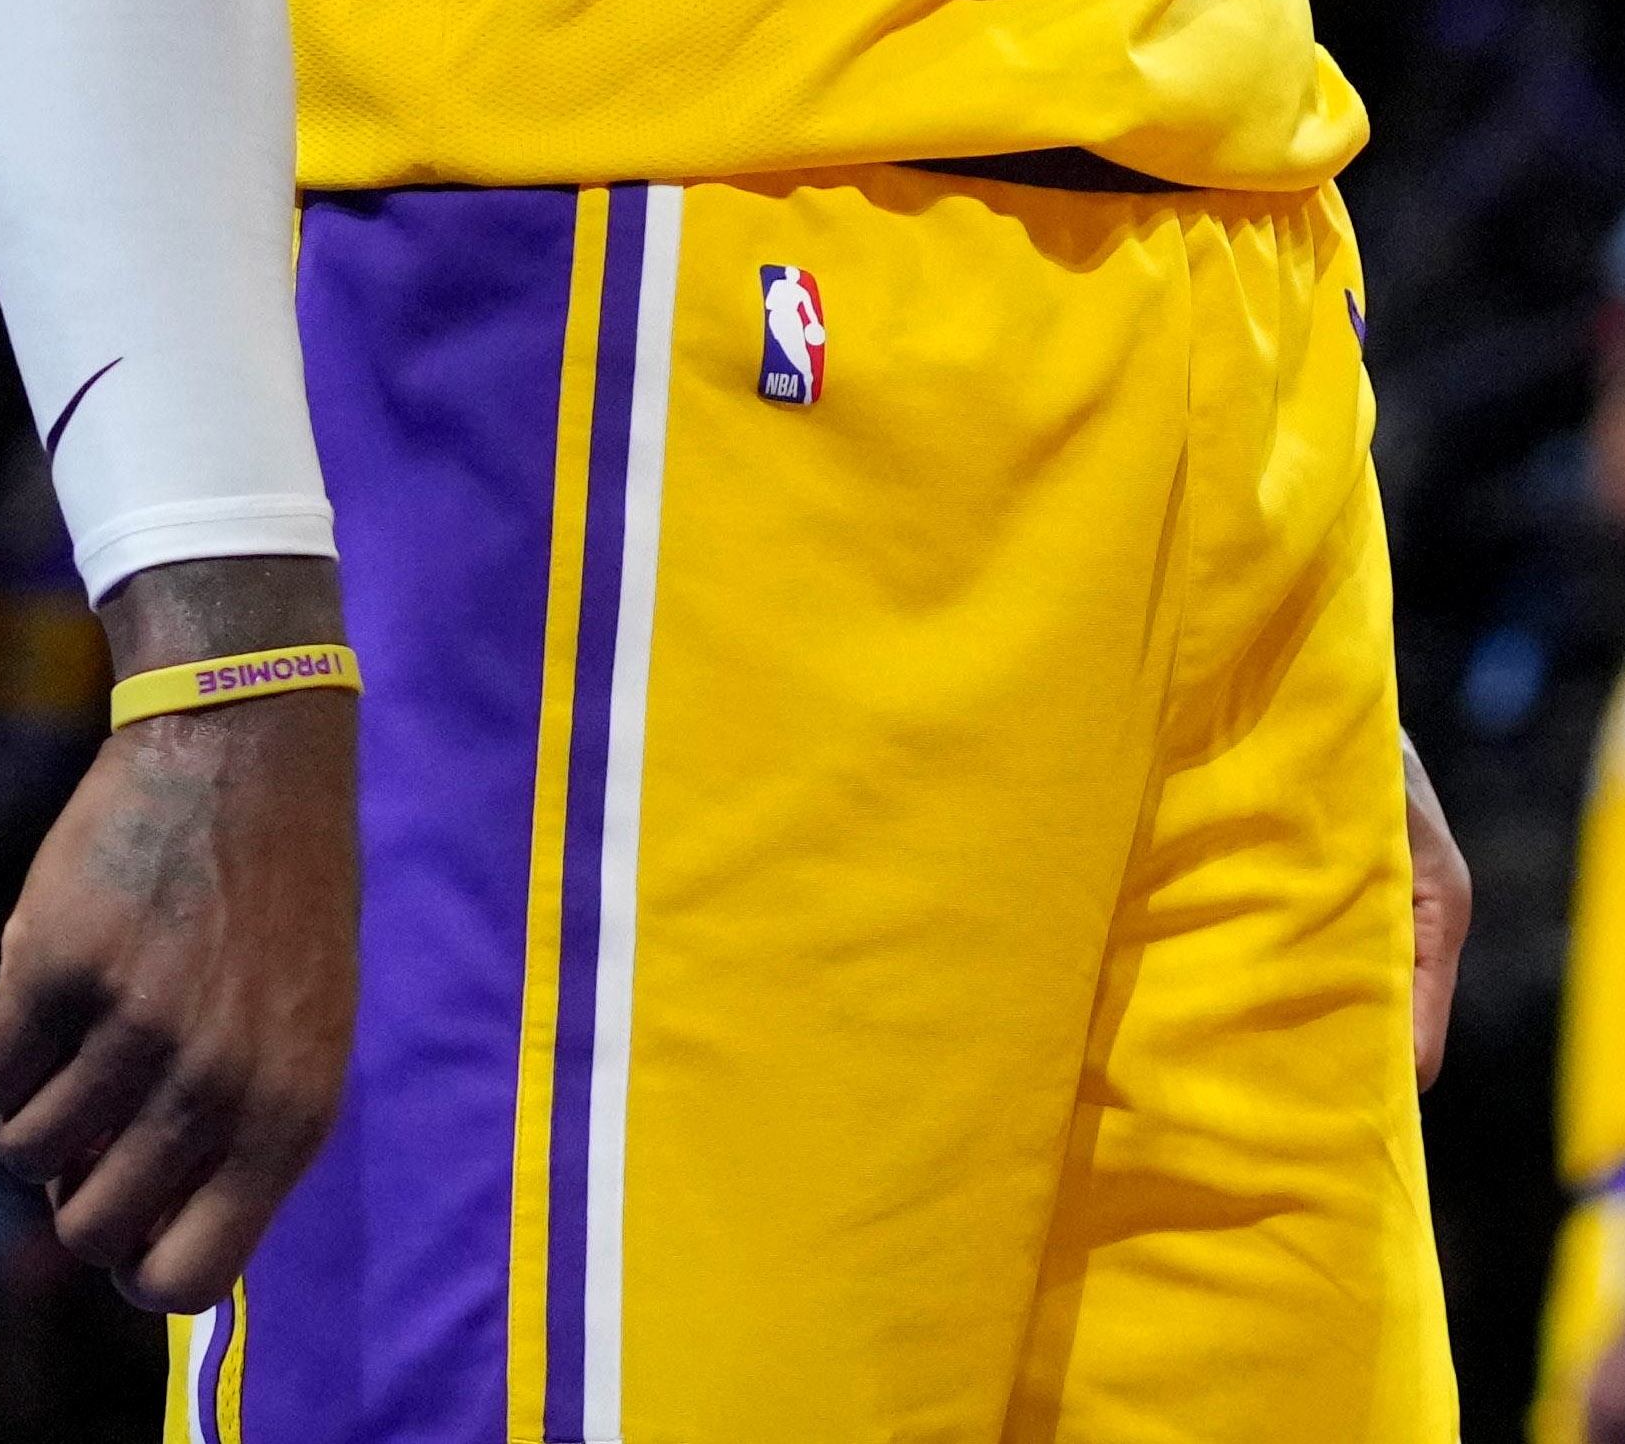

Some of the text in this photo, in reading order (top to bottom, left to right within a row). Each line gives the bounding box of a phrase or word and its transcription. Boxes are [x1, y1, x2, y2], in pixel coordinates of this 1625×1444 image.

[765, 372, 799, 398] NBA
[198, 653, 342, 694] I PROMISE
